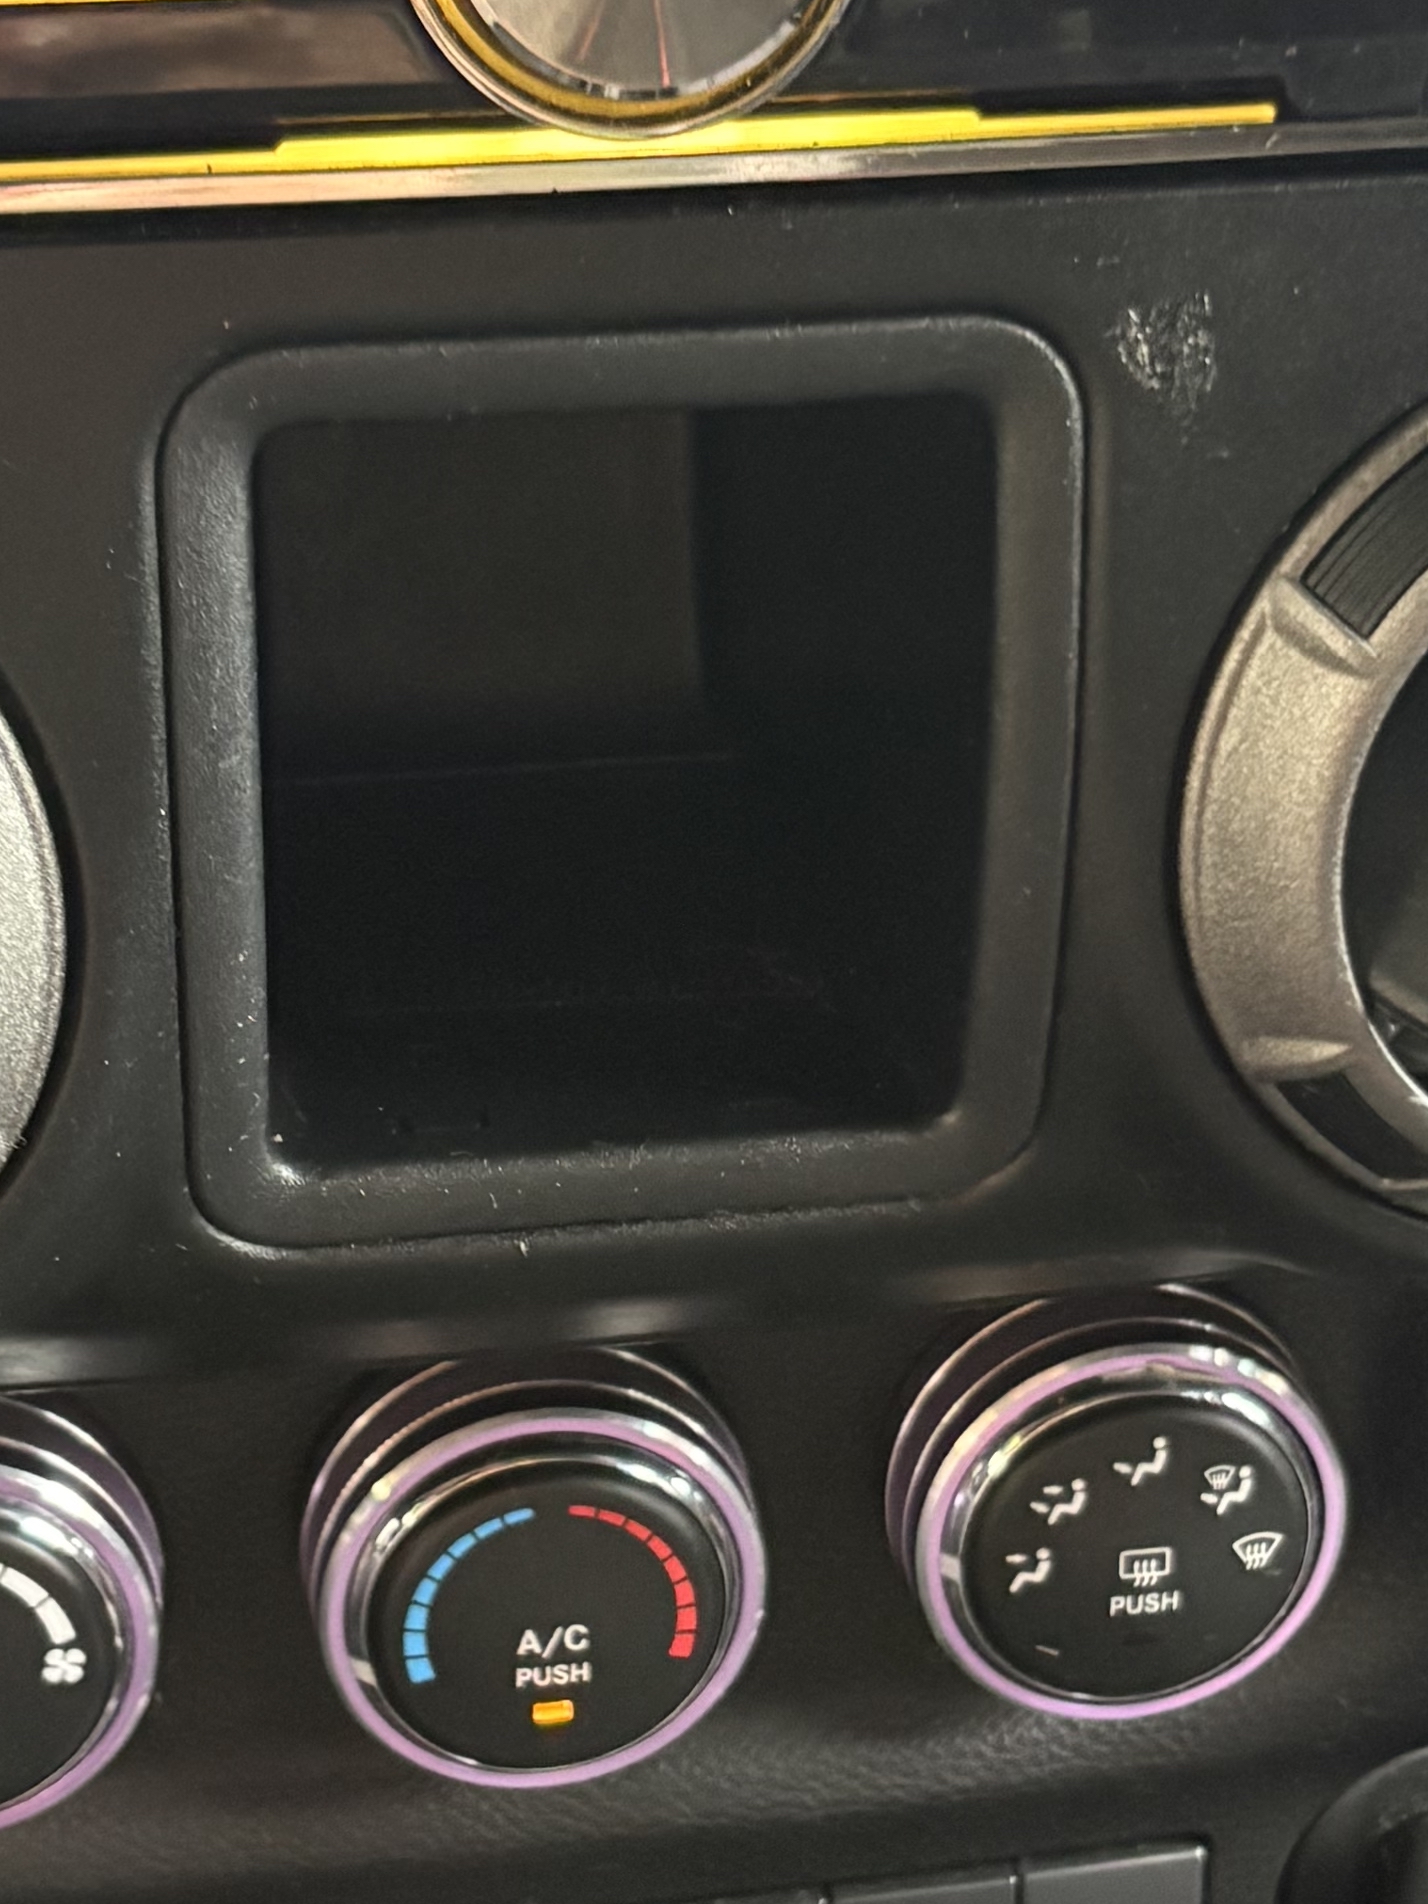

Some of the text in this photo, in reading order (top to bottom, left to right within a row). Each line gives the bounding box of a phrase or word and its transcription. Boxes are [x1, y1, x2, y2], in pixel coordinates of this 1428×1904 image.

[1109, 1591, 1179, 1617] PUSH
[517, 1625, 590, 1657] A/C
[515, 1661, 591, 1687] PUSH
